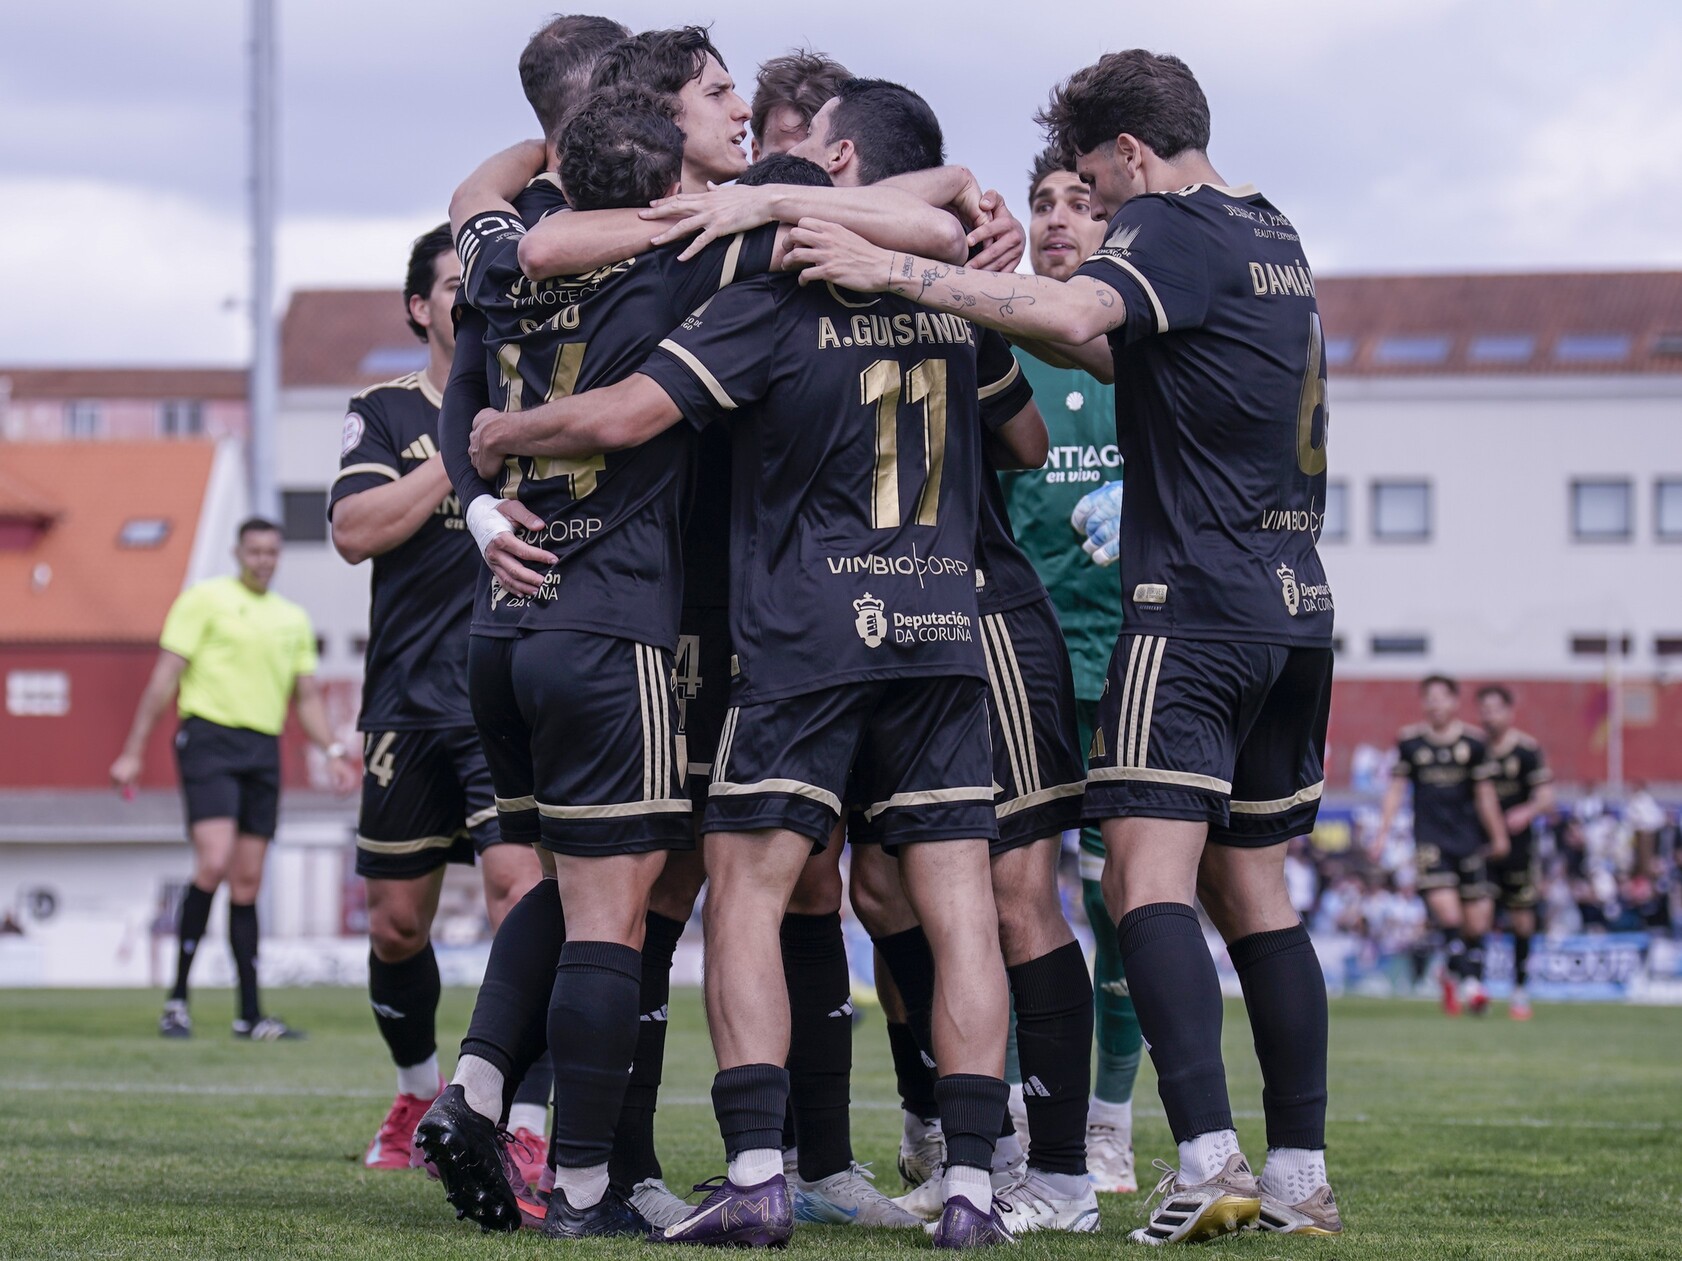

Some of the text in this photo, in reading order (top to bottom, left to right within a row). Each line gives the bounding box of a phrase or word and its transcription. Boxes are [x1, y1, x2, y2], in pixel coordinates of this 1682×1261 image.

[1253, 227, 1277, 239] BEAUTY
[818, 312, 975, 350] A.GUISANDE
[1296, 311, 1329, 477] 6
[860, 358, 947, 529] 11
[1043, 444, 1124, 470] NTIAG
[1045, 468, 1101, 484] en vivo
[1302, 598, 1317, 612] DA
[893, 611, 971, 629] Deputación
[895, 625, 973, 644] DA CORUÑA
[363, 731, 397, 788] 4
